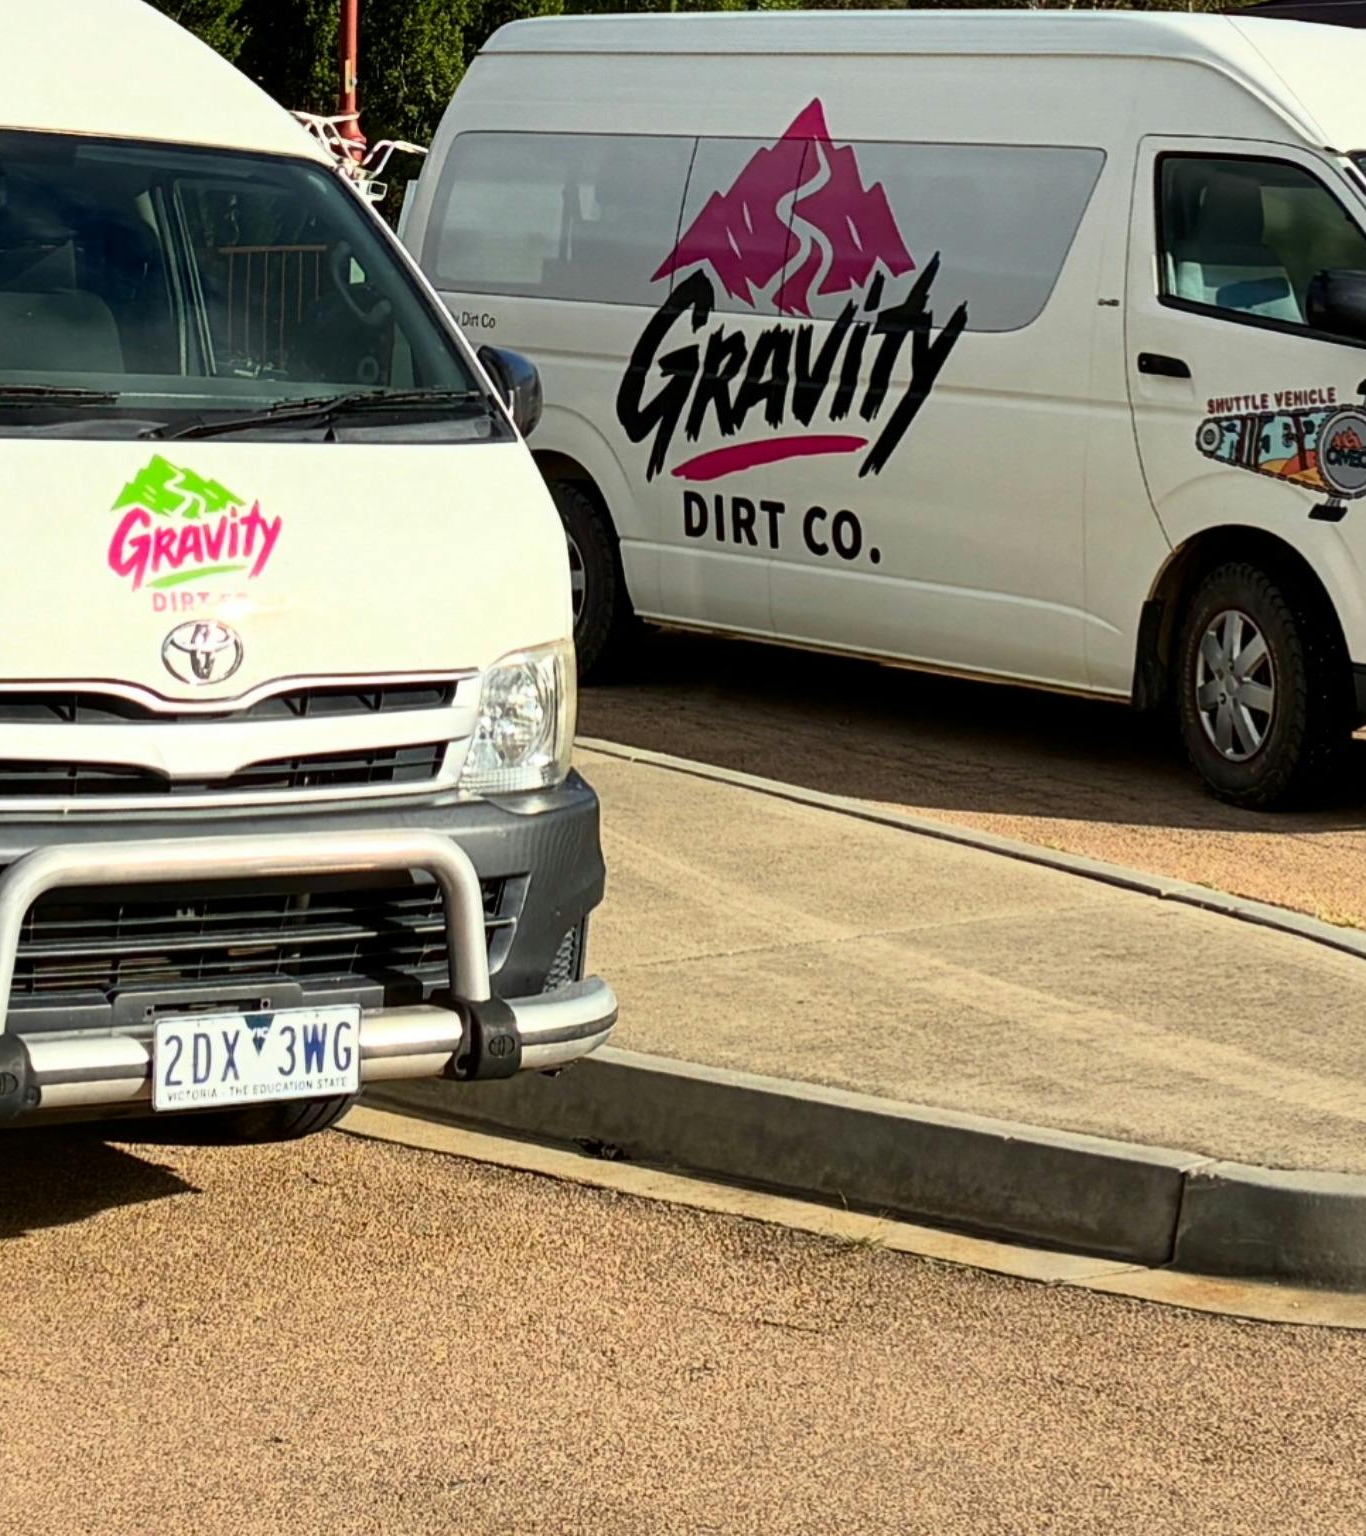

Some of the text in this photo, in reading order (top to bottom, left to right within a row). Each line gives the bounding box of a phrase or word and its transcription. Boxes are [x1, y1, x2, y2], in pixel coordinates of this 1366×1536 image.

[462, 311, 479, 327] Dirt
[481, 313, 496, 328] Co
[1207, 386, 1337, 415] SHUTTLE VEHICLE
[683, 490, 881, 564] DIRT CO.
[164, 1021, 352, 1087] 2DX 3WG
[167, 1088, 218, 1102] VICTORIA
[229, 1085, 248, 1097] THE
[252, 1079, 313, 1095] EDUCATION
[317, 1076, 348, 1089] STATE
